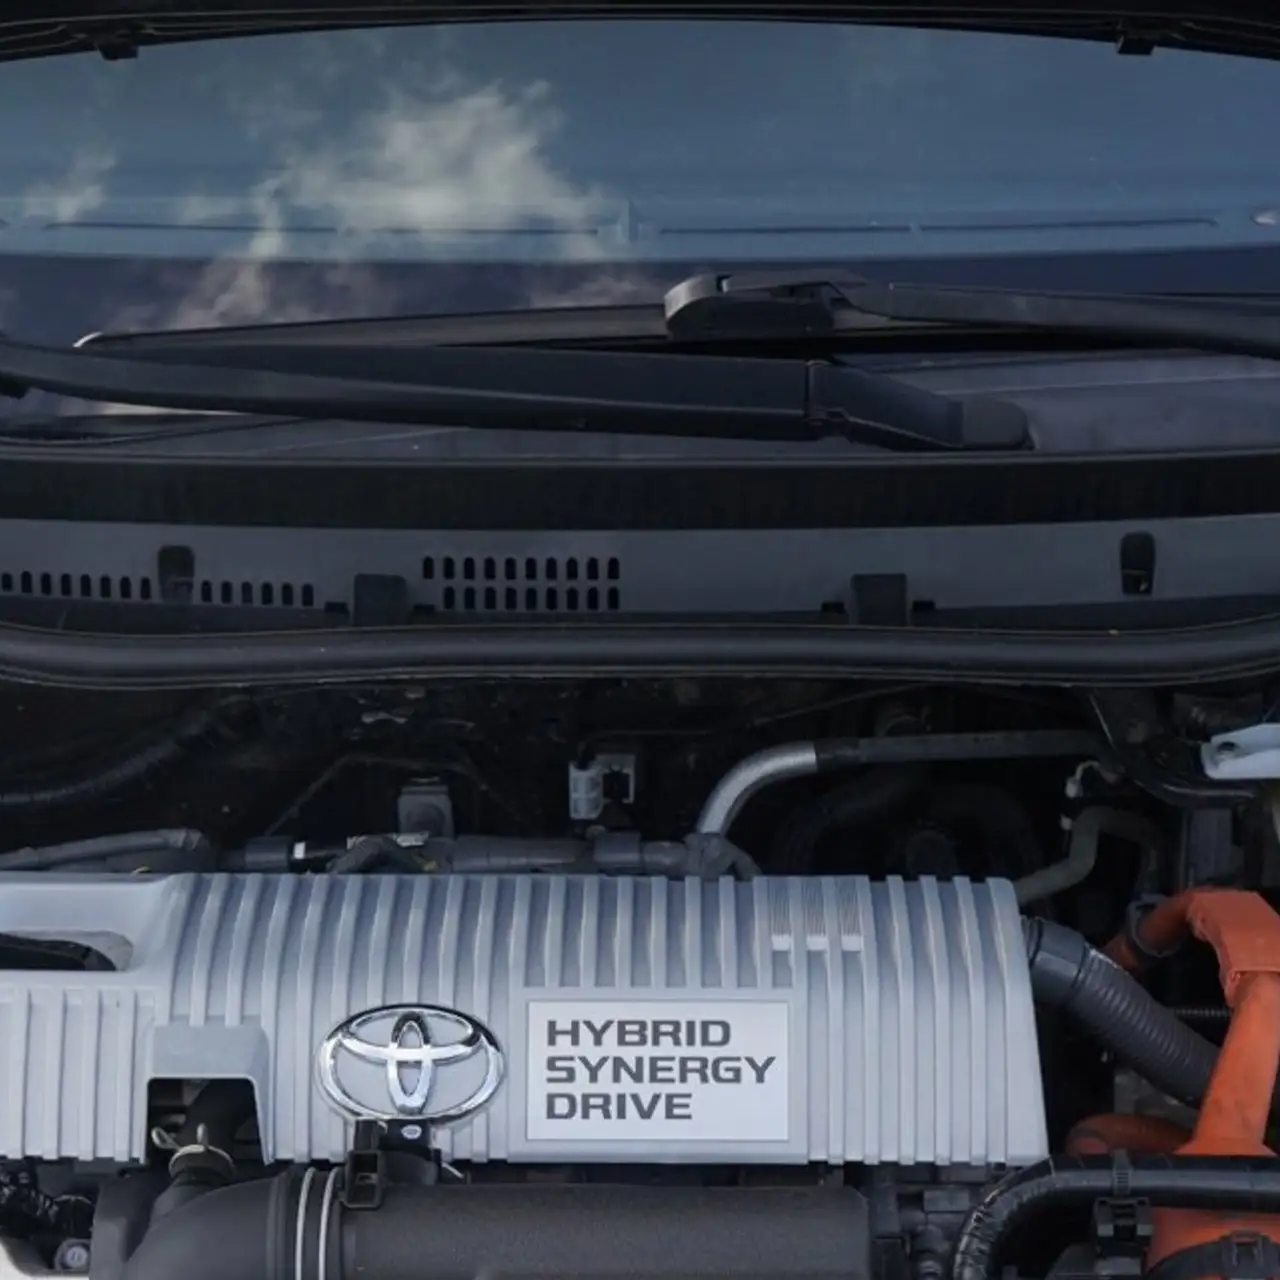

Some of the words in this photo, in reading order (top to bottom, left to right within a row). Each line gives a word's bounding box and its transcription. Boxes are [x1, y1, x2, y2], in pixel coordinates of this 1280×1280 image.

[546, 1019, 732, 1047] HYBRID
[545, 1055, 777, 1084] SYNERGY
[545, 1092, 693, 1120] DRIVE
